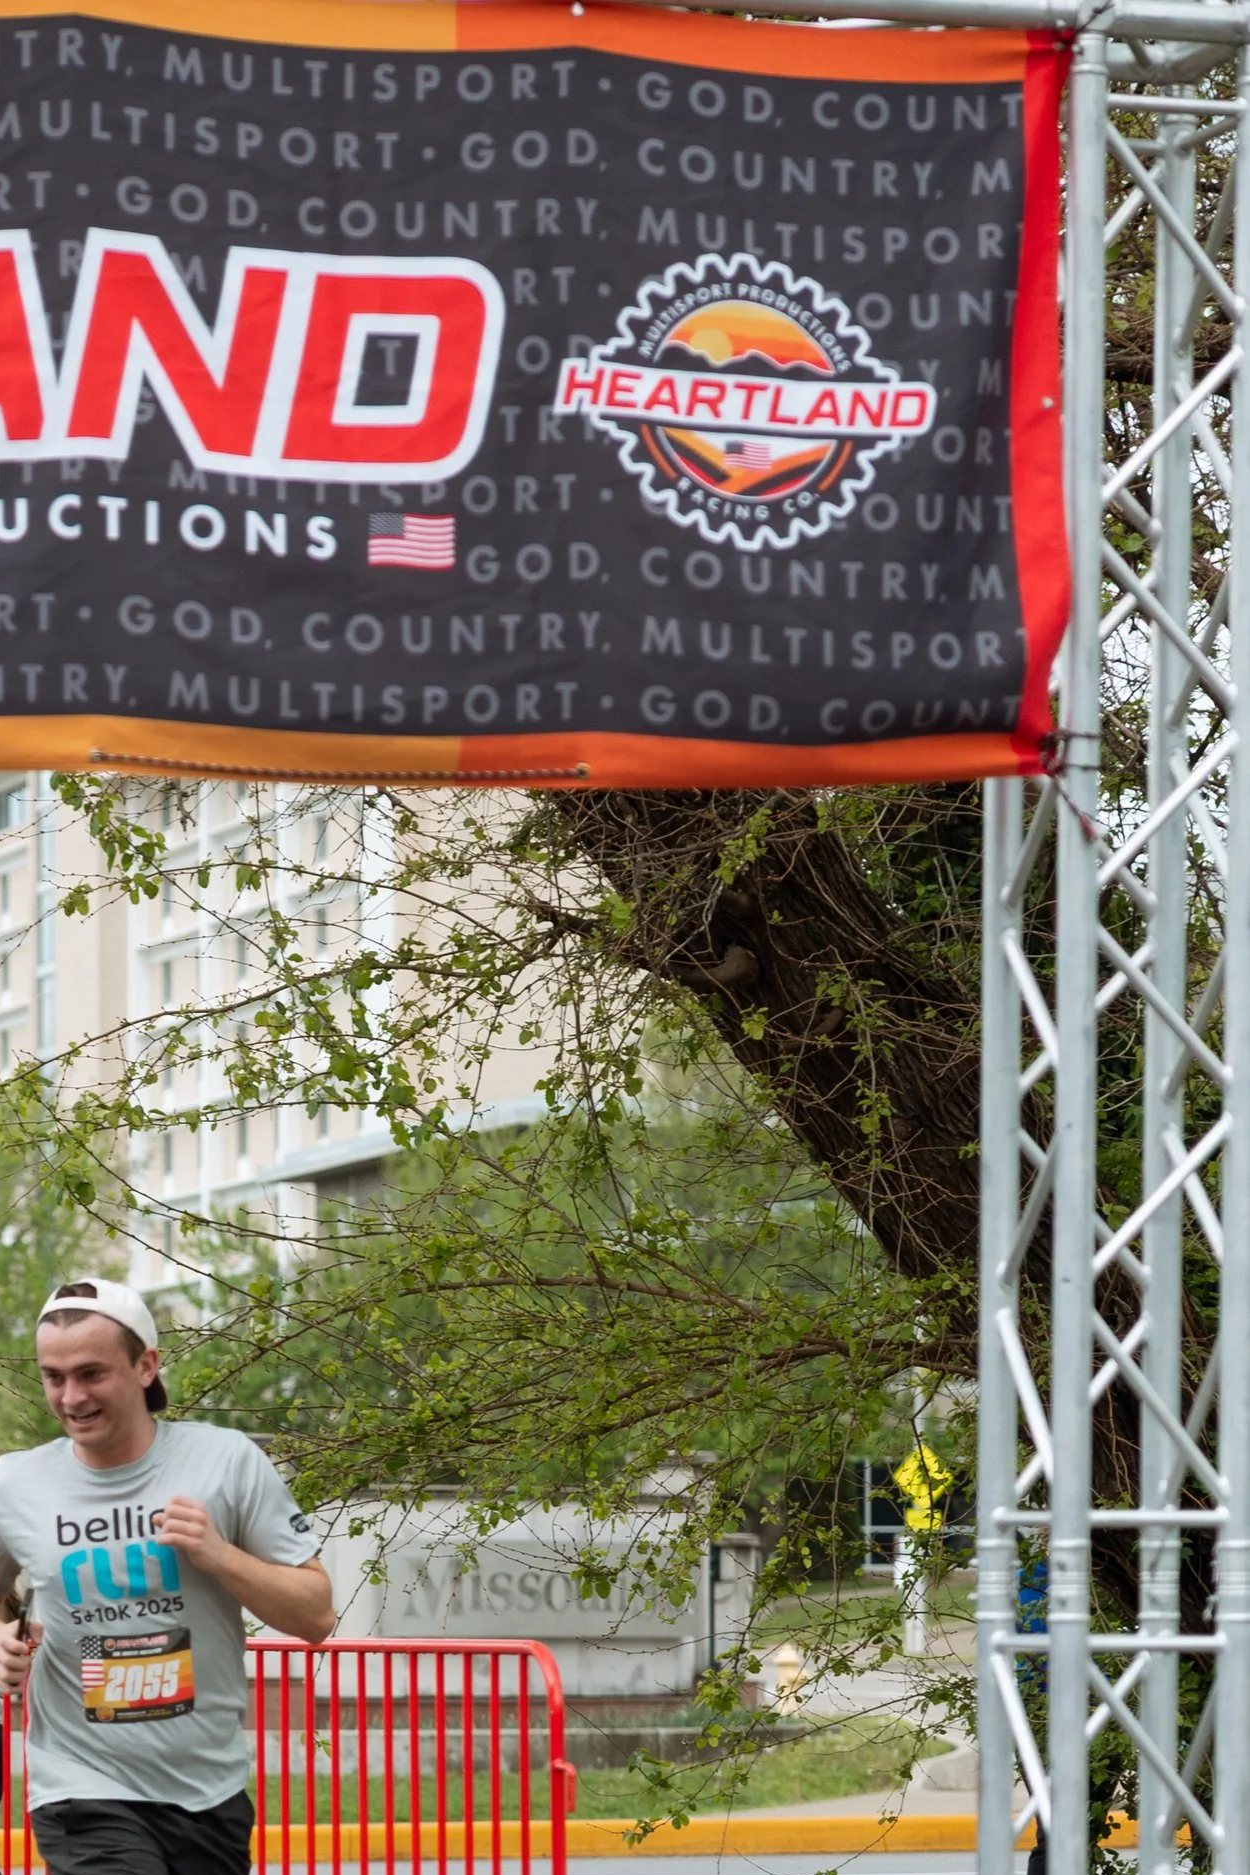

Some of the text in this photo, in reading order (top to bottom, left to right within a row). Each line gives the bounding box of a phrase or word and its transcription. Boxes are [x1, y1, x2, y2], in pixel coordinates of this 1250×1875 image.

[164, 45, 575, 102] MULTISPORT
[637, 72, 783, 126] GOD,
[461, 129, 607, 172] GOD,
[638, 138, 942, 200] COUNTRY,
[116, 176, 268, 232] GOD,
[298, 197, 607, 240] COUNTRY,
[637, 206, 1022, 265] MULTISPOR
[639, 282, 732, 359] MULTISPORT
[560, 364, 932, 430] HEARTLAND
[675, 476, 770, 520] RACING
[466, 542, 607, 584] GOD,
[640, 547, 947, 604] COUNTRY,
[119, 596, 272, 649] GOD,
[302, 612, 610, 654] COUNTRY,
[168, 671, 577, 724] MULTISPORT
[640, 685, 789, 736] GOD,
[61, 1540, 181, 1606] run
[135, 1596, 184, 1617] 2025
[104, 1658, 180, 1703] 2055
